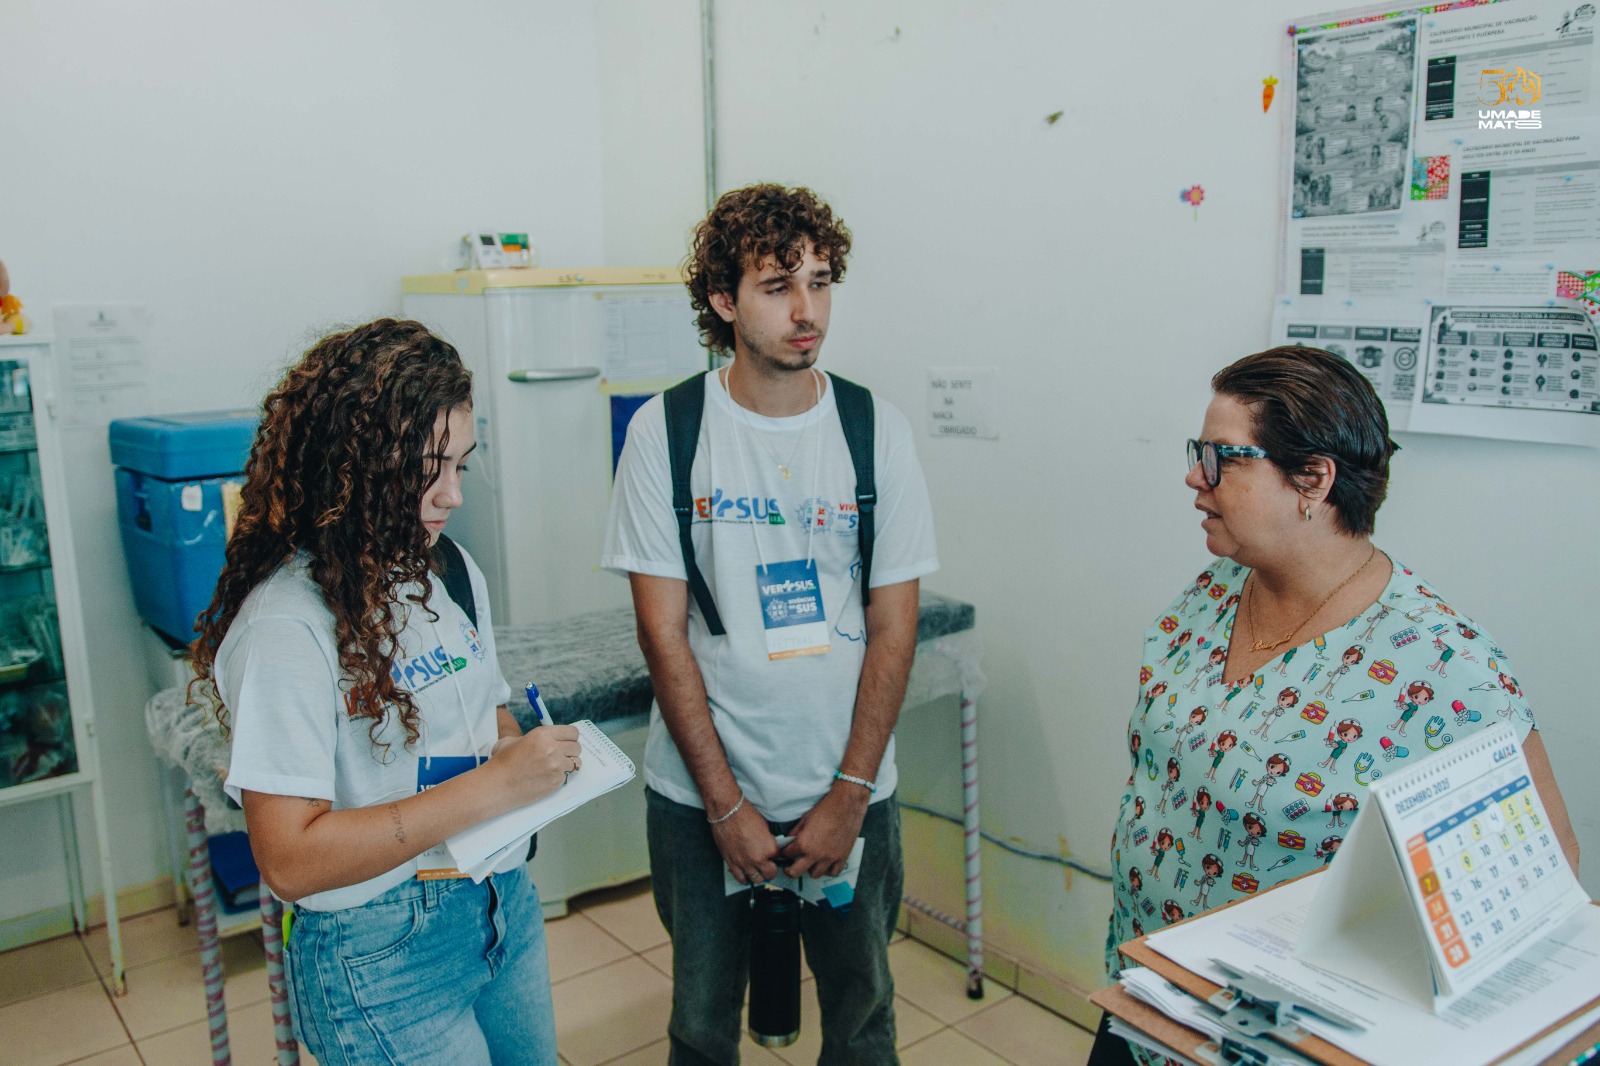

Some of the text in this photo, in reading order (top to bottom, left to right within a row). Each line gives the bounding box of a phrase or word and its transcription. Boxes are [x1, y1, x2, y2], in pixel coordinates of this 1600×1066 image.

[796, 602, 817, 614] SUS
[1493, 743, 1517, 763] CAIXA
[1395, 778, 1451, 814] DEZEMBRO 2025
[1438, 845, 1444, 857] 1
[1456, 834, 1463, 846] 2
[1507, 804, 1515, 816] 5
[1524, 795, 1531, 806] 6
[1445, 867, 1452, 880] 8
[1464, 855, 1471, 868] 9
[1481, 844, 1491, 857] 10
[1500, 835, 1510, 846] 11
[1514, 822, 1525, 836] 12
[1452, 890, 1463, 903] 15
[1471, 878, 1482, 890] 16
[1489, 866, 1500, 878] 17
[1509, 855, 1519, 867] 18
[1524, 844, 1534, 856] 19
[1539, 834, 1550, 847] 20
[1460, 911, 1473, 926] 22
[1480, 899, 1494, 912] 23
[1499, 887, 1511, 900] 24
[1518, 877, 1529, 889] 25
[1533, 866, 1544, 878] 26
[1549, 855, 1559, 867] 27
[1470, 932, 1484, 948] 29
[1491, 919, 1504, 934] 30
[1510, 908, 1521, 921] 31
